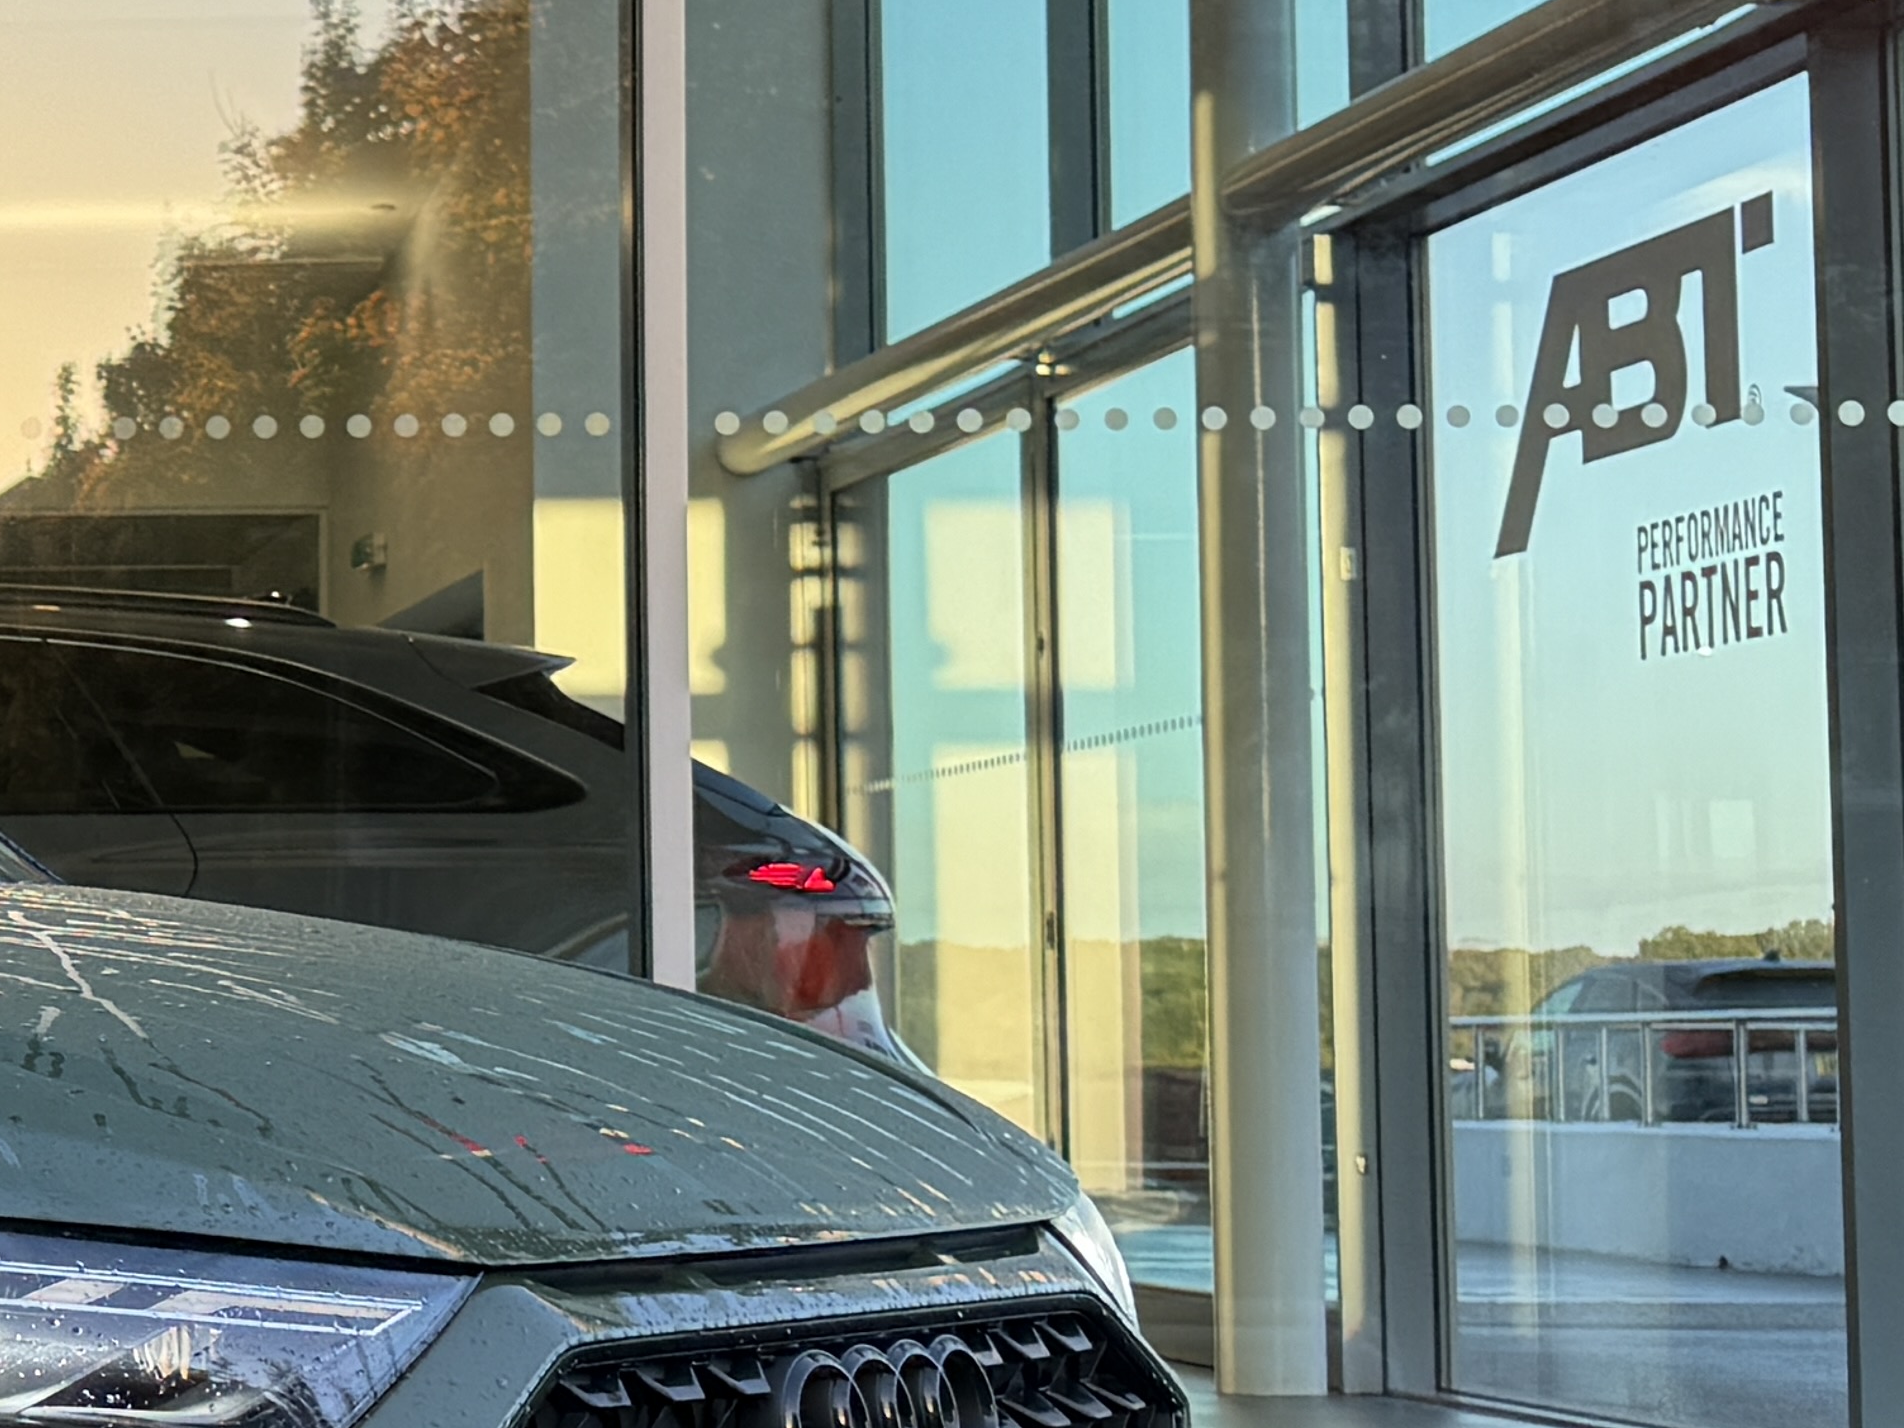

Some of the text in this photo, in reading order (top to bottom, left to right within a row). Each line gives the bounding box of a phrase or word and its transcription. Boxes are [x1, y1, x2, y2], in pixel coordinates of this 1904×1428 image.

[1492, 189, 1775, 560] ABT
[1636, 490, 1786, 575] PERFORMANCE
[1637, 550, 1789, 661] PARTNER
